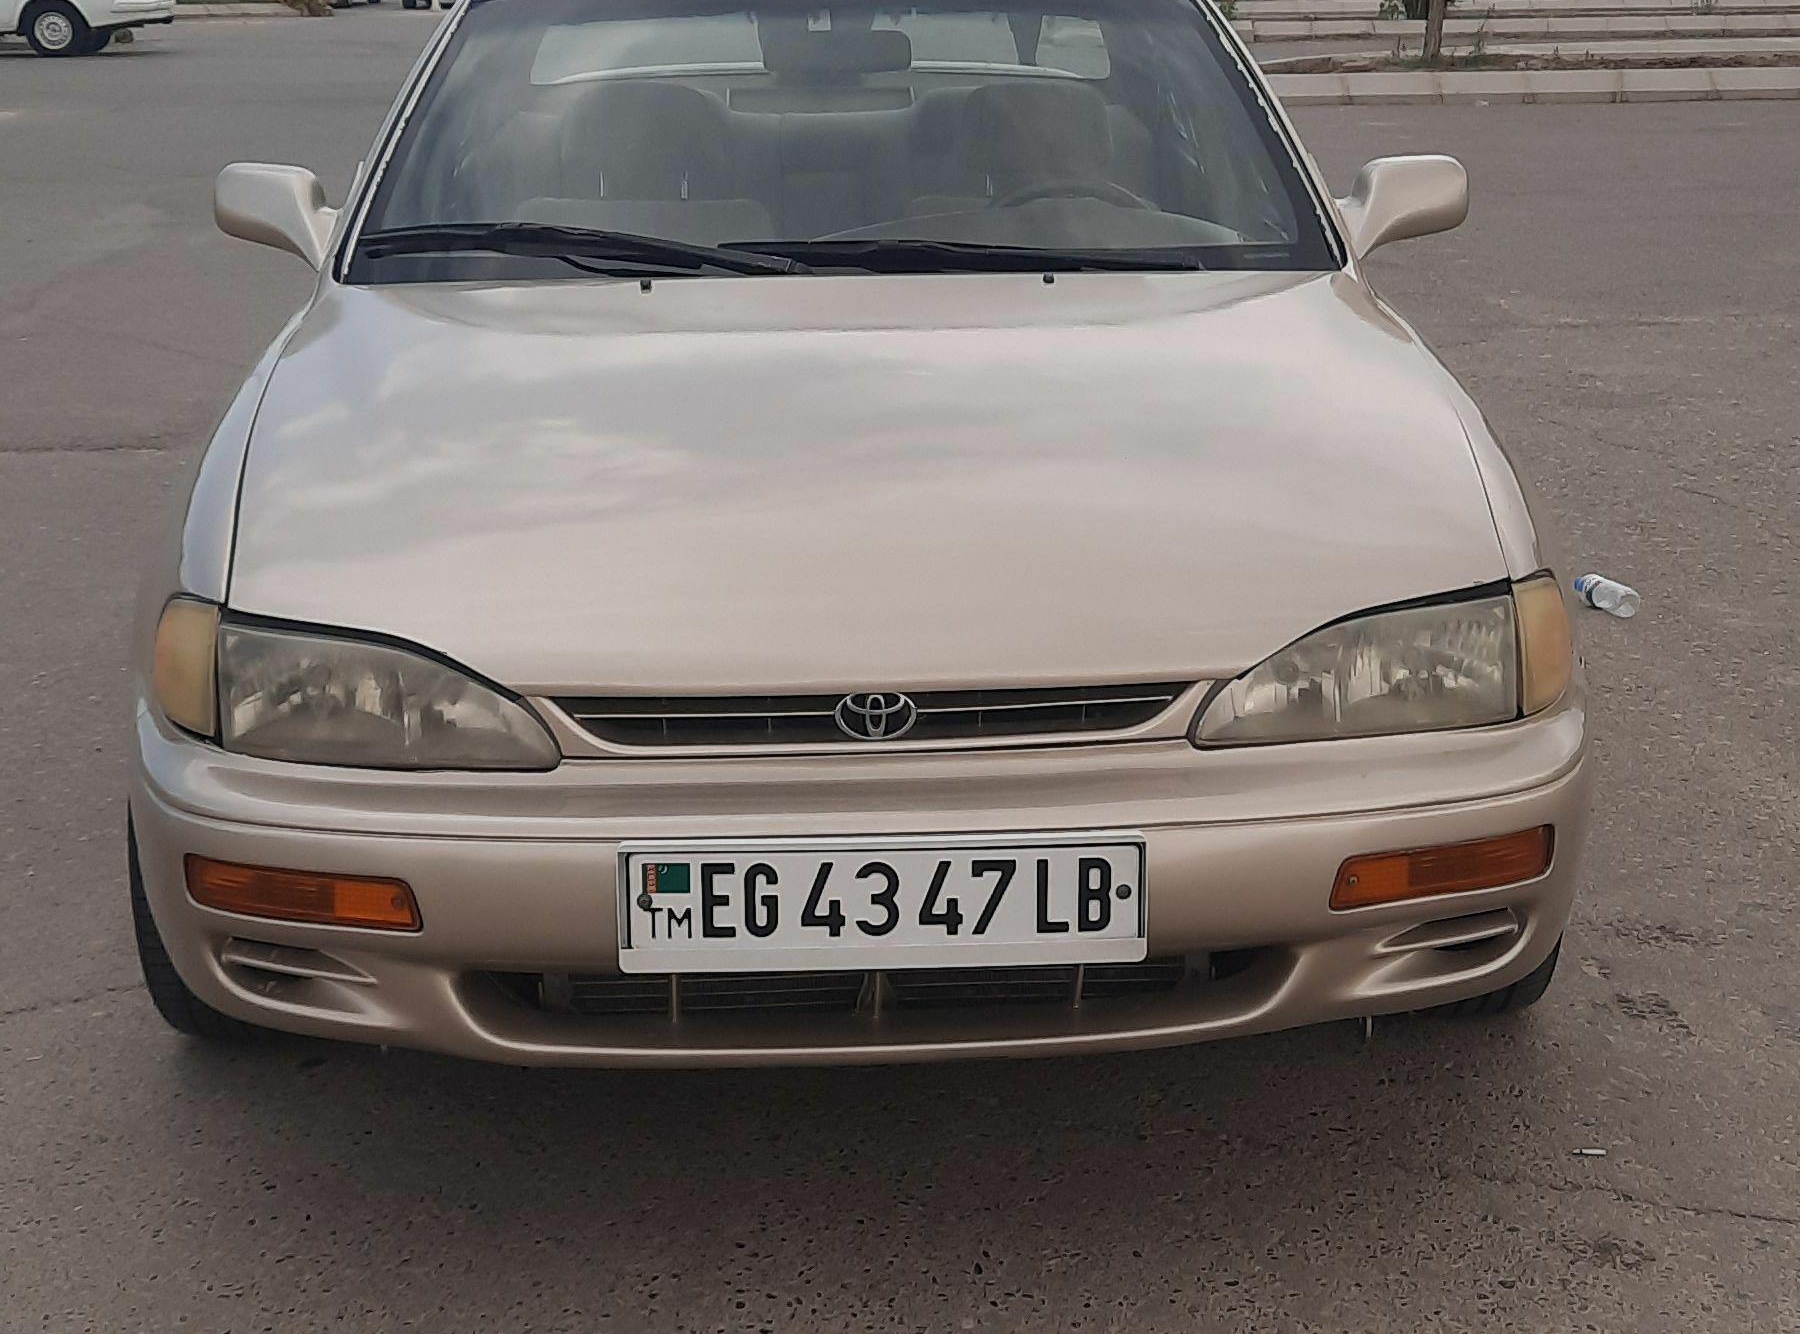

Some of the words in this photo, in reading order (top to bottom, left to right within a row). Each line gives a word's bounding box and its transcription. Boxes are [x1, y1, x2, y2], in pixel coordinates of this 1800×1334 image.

[647, 906, 692, 940] TM
[701, 862, 779, 937] EG
[801, 861, 900, 937] 43
[918, 859, 1017, 935] 47
[1036, 857, 1112, 933] LB
